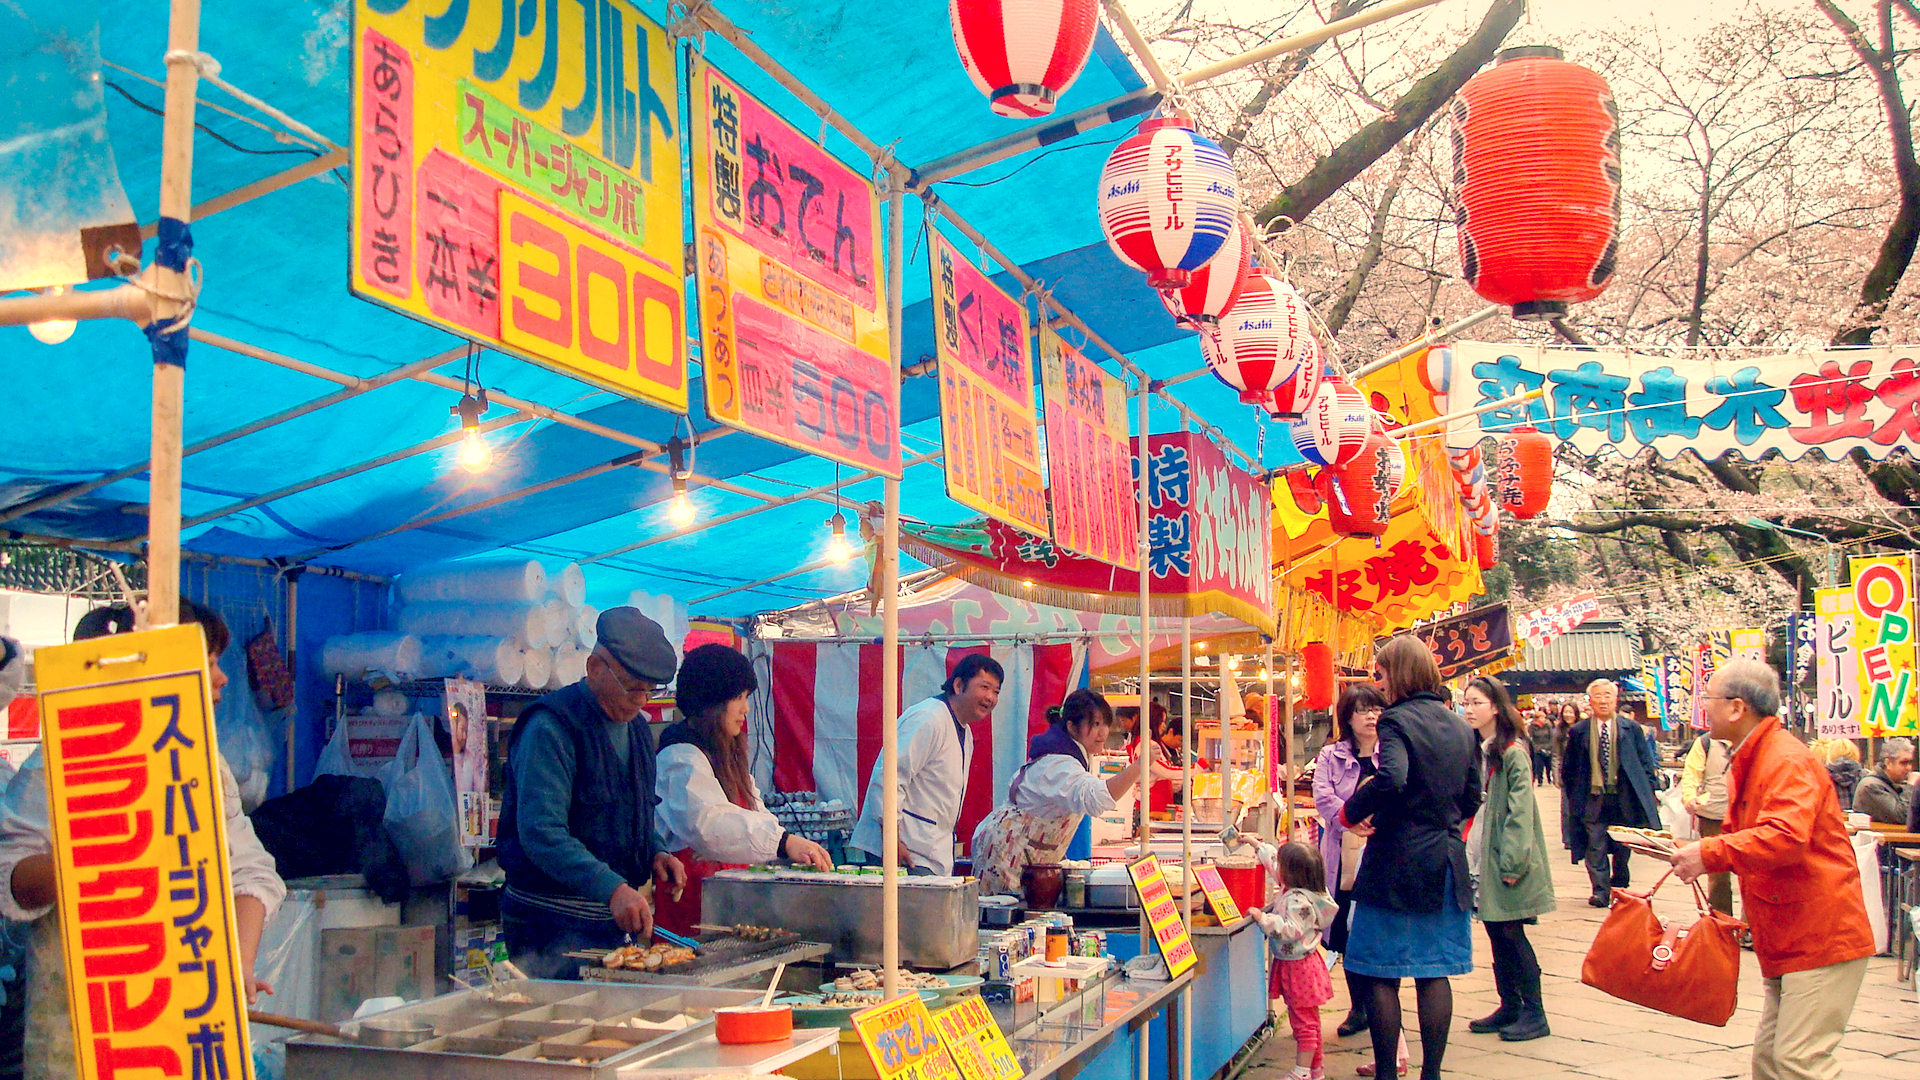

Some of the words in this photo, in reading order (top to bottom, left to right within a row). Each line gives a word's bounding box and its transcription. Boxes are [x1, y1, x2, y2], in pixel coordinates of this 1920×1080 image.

[372, 42, 402, 285] あらびき
[462, 91, 642, 237] スーパージャンボ
[711, 82, 743, 227] 特製
[744, 130, 868, 290] おでん
[1106, 178, 1141, 200] Asahi
[1163, 145, 1185, 231] アサヒビール
[708, 237, 735, 410] あつあつ
[1238, 318, 1273, 331] Asahi
[1282, 292, 1299, 361] アサヒビール
[1318, 395, 1333, 447] アサヒビール
[1827, 619, 1853, 720] ビール
[1854, 562, 1911, 732] OPEN
[1820, 723, 1862, 736] あります!
[57, 697, 183, 1080] フランクフルト
[150, 694, 230, 1080] スーパージャンボ
[874, 1013, 939, 1068] おでん
